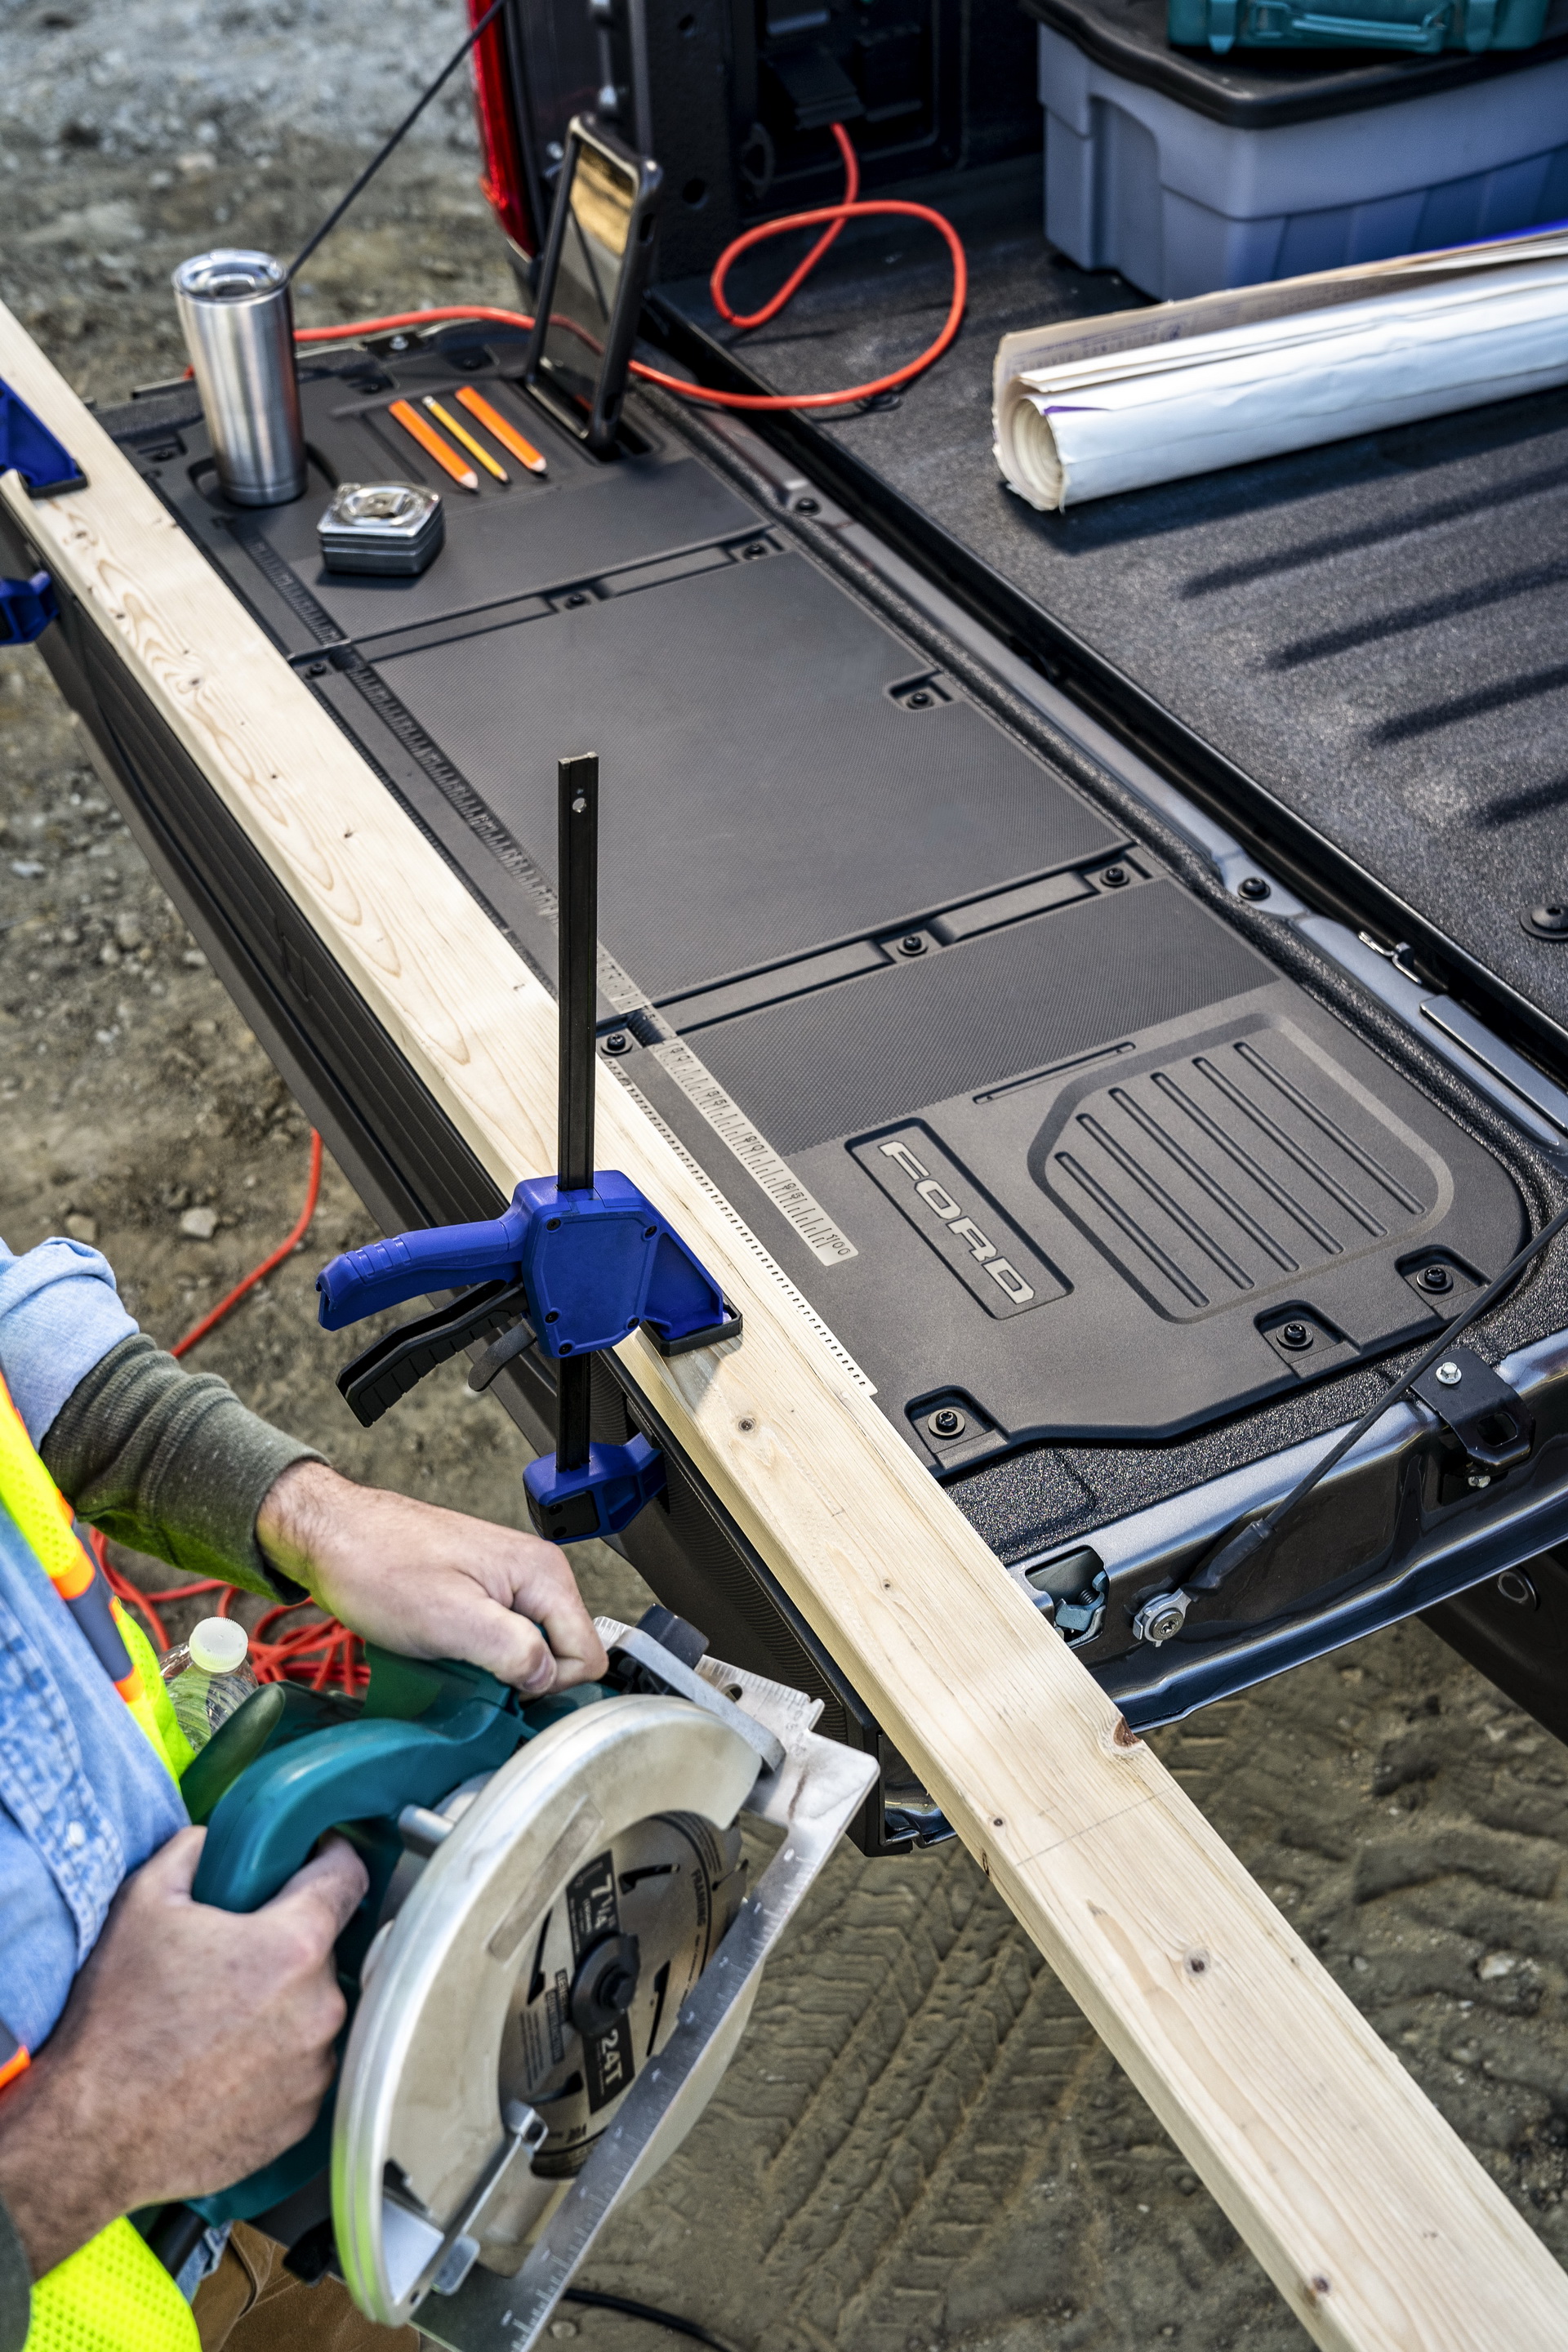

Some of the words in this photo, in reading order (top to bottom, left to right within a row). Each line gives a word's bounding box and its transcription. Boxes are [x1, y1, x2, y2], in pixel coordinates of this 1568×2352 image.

[826, 1232, 852, 1257] 100
[877, 1141, 1036, 1305] FORD
[601, 2028, 624, 2086] 24T
